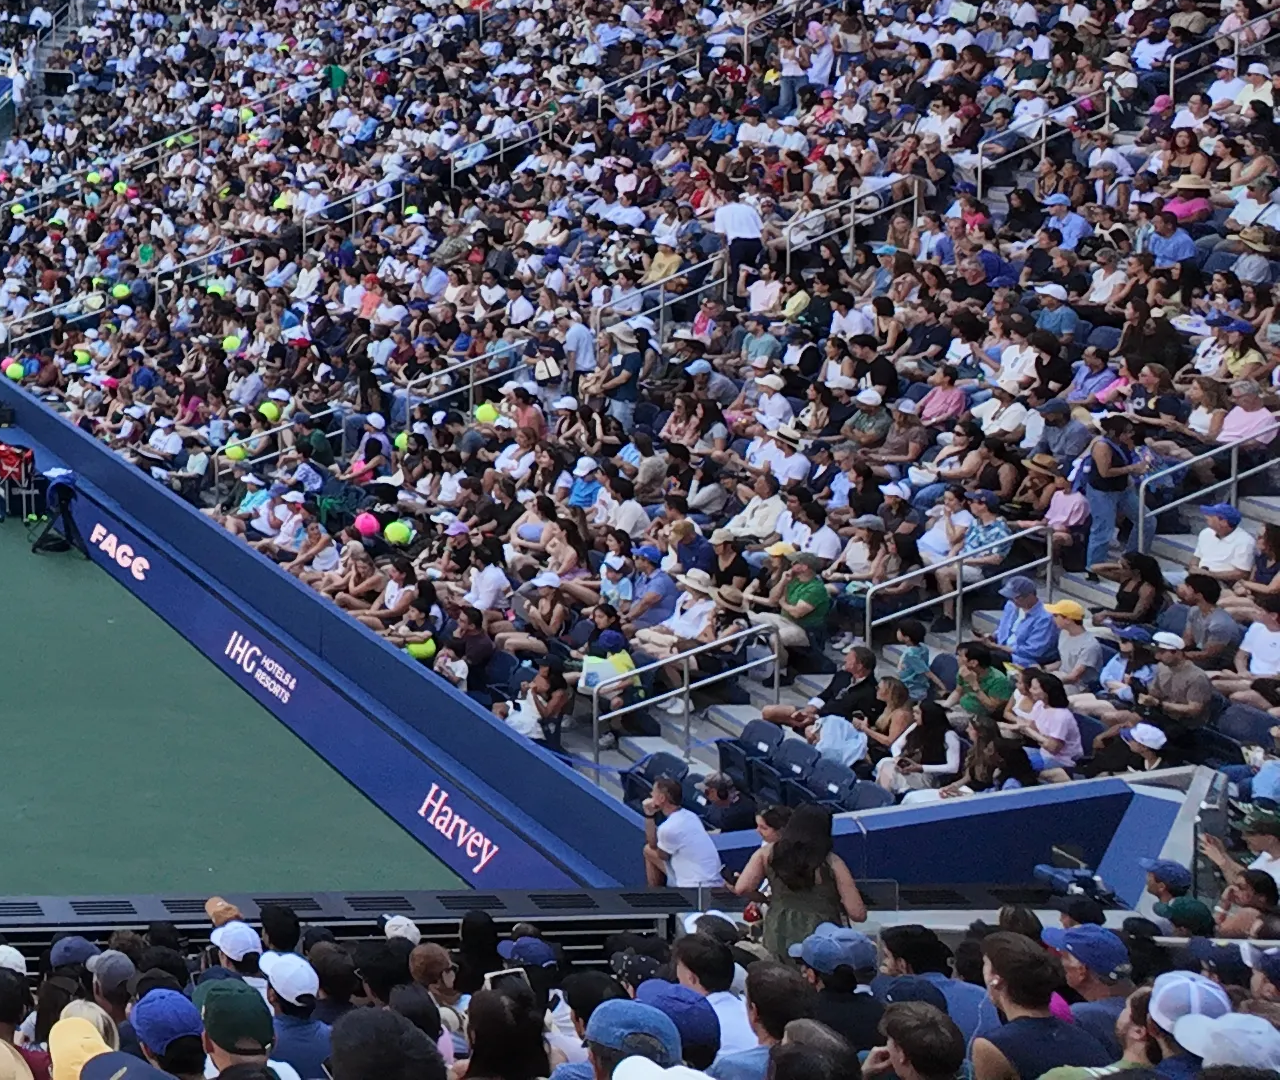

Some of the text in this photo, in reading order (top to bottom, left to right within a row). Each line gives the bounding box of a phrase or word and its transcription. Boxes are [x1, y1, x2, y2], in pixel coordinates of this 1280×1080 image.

[89, 522, 151, 581] FAGE
[224, 630, 262, 673] IHG
[260, 655, 297, 690] HOTELS &
[254, 668, 291, 704] RESORTS
[417, 782, 499, 874] Harvey
